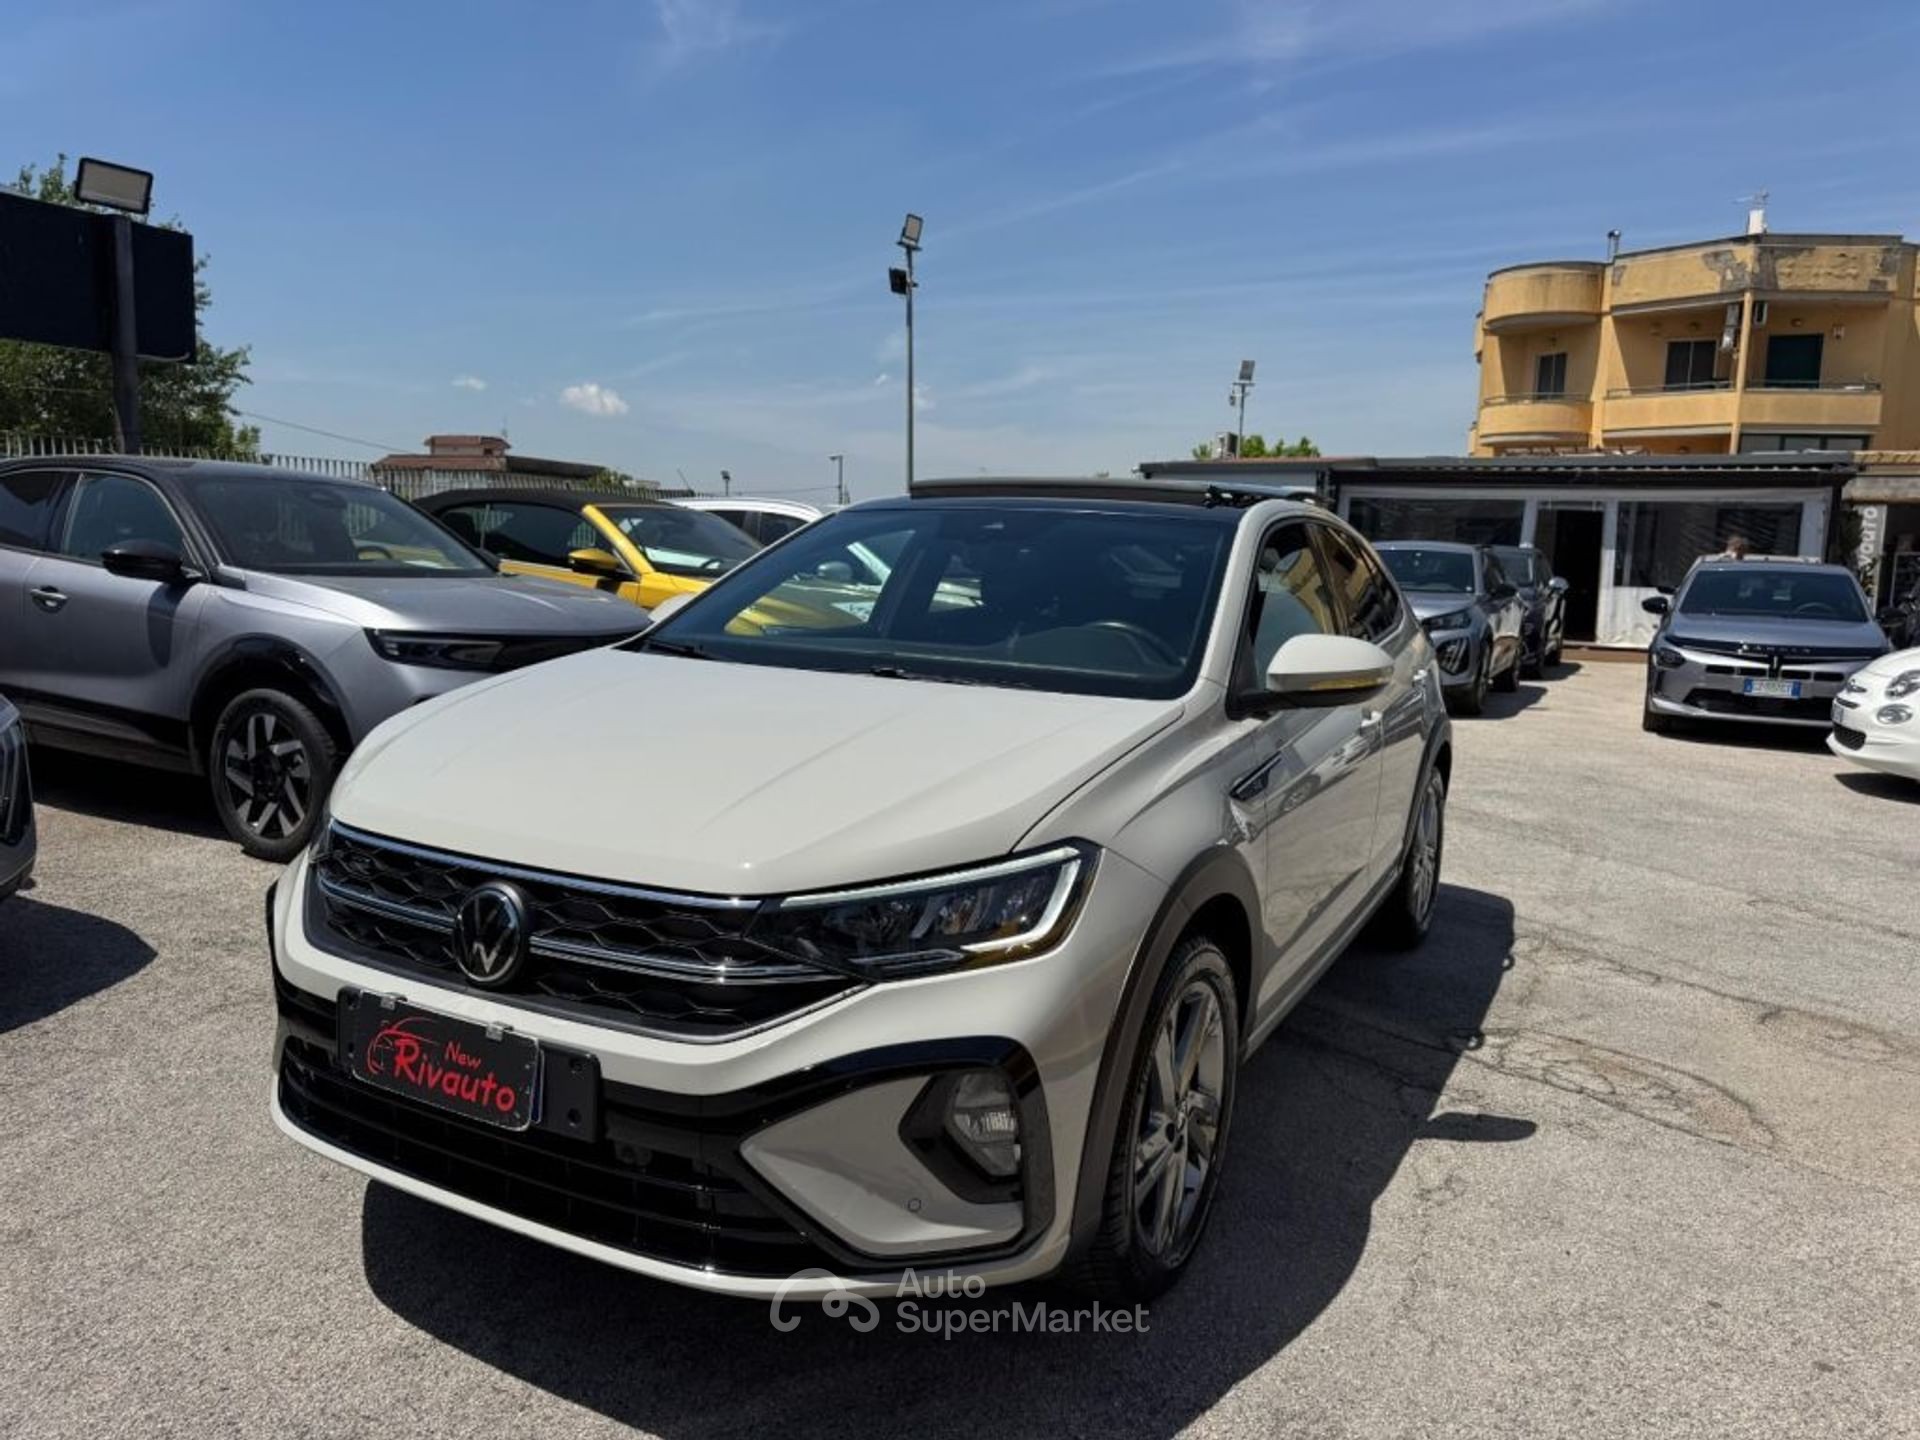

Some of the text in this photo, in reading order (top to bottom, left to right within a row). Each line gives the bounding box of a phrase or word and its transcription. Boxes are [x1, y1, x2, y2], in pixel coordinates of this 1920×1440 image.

[1857, 506, 1879, 586] vauto
[393, 1037, 516, 1113] Rivauto
[444, 1040, 482, 1069] New
